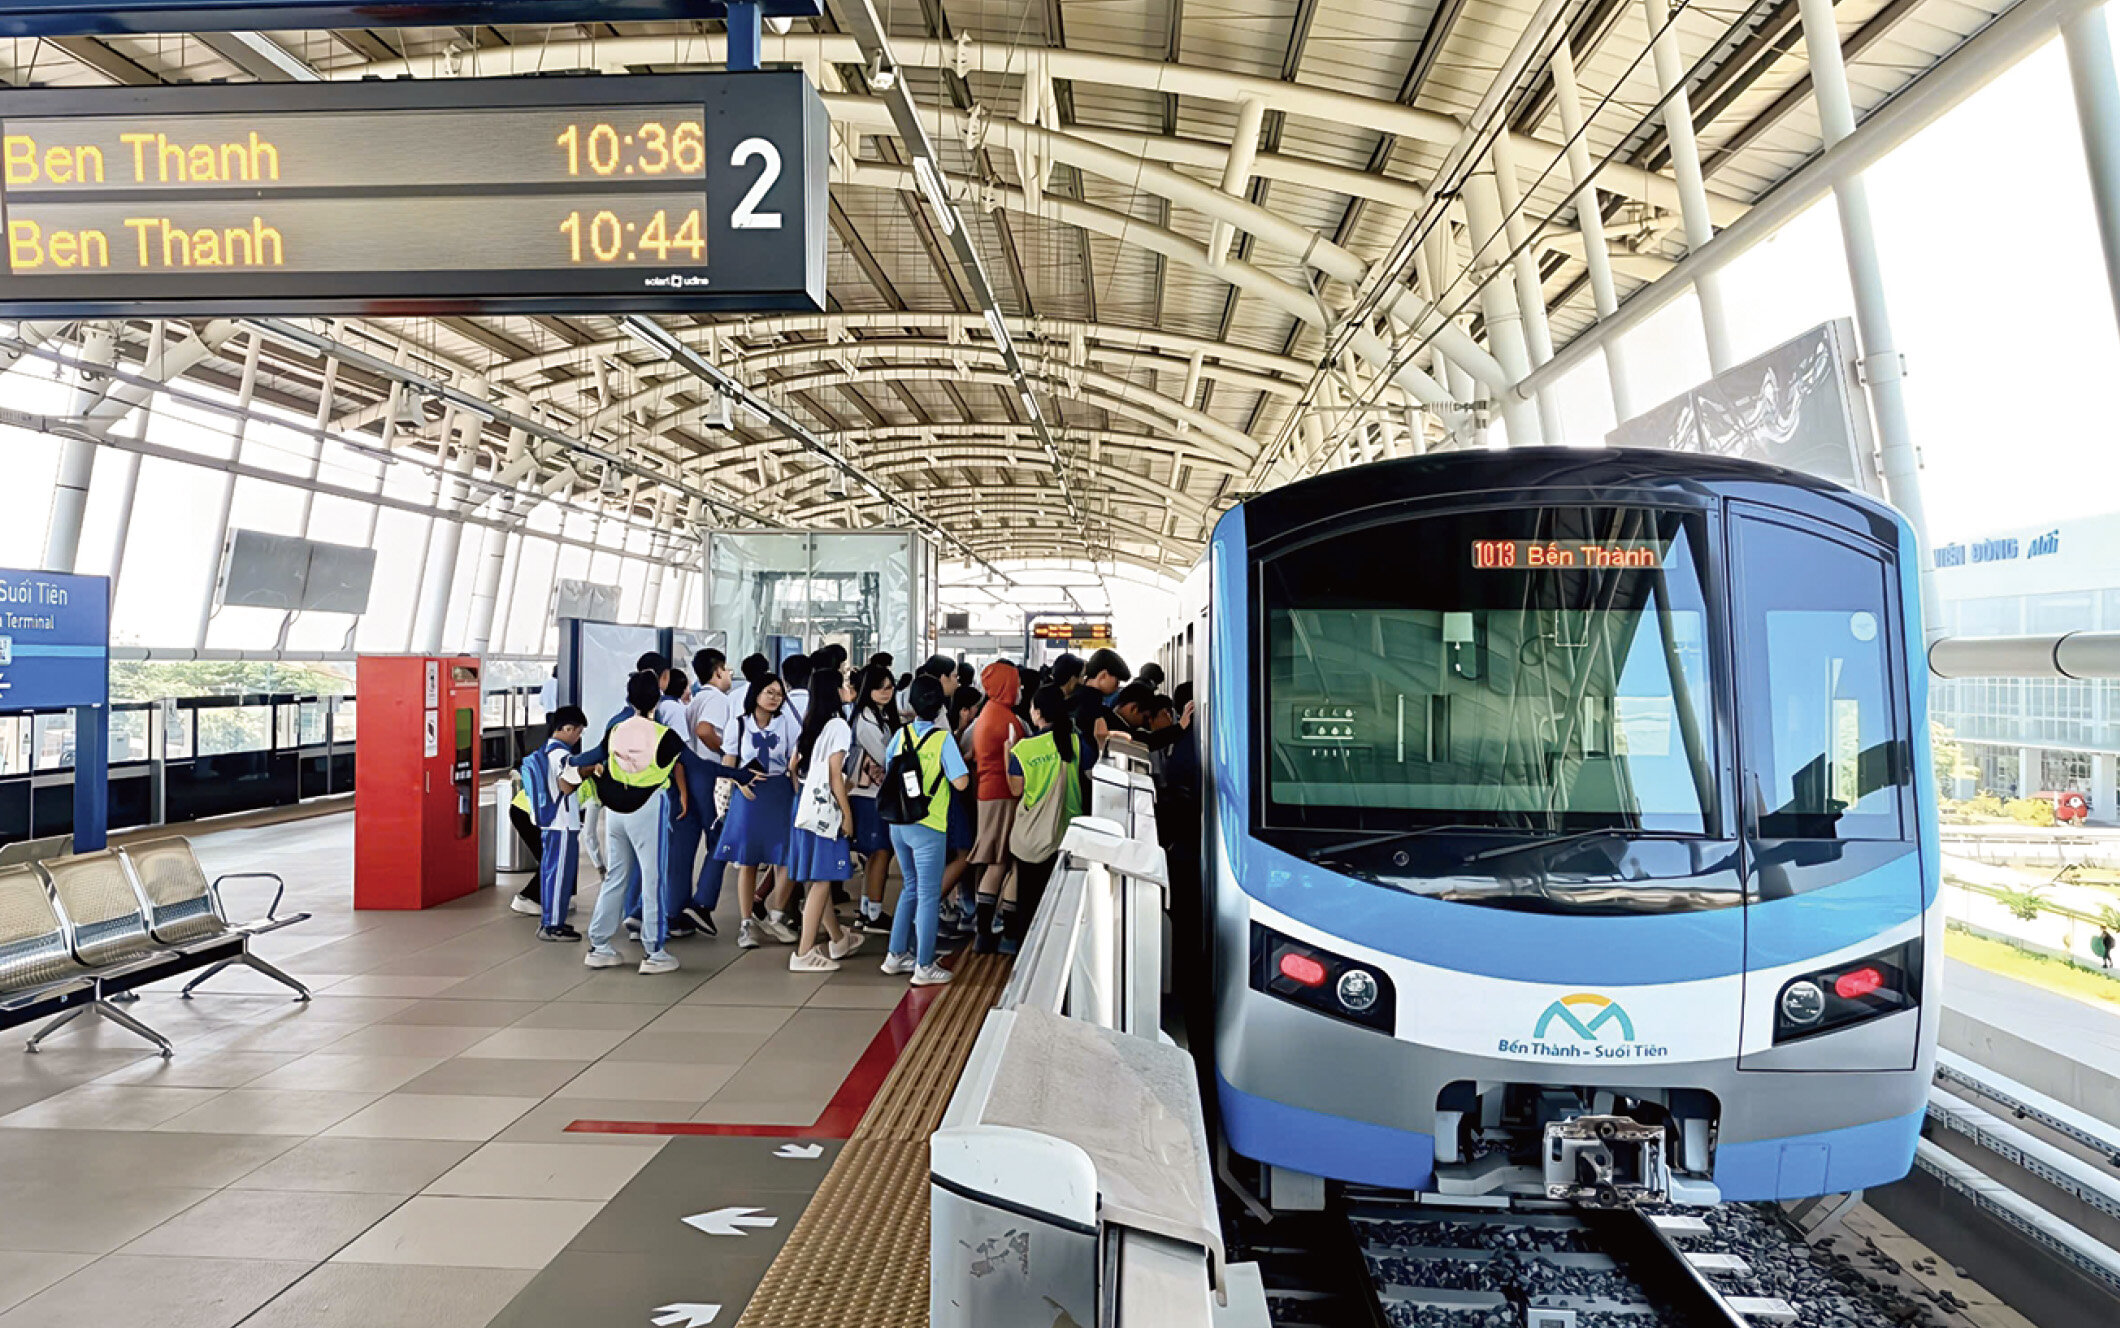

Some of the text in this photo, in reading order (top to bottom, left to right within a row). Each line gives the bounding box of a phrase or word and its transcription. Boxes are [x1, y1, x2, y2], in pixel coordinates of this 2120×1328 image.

[4, 122, 704, 184] Ben Thanh 10:36
[730, 137, 783, 229] 2
[8, 208, 706, 269] Ben Thanh 10:44
[1474, 541, 1655, 567] 1013 Bến Thành
[36, 582, 68, 606] Tiên
[5, 611, 55, 630] Terminal
